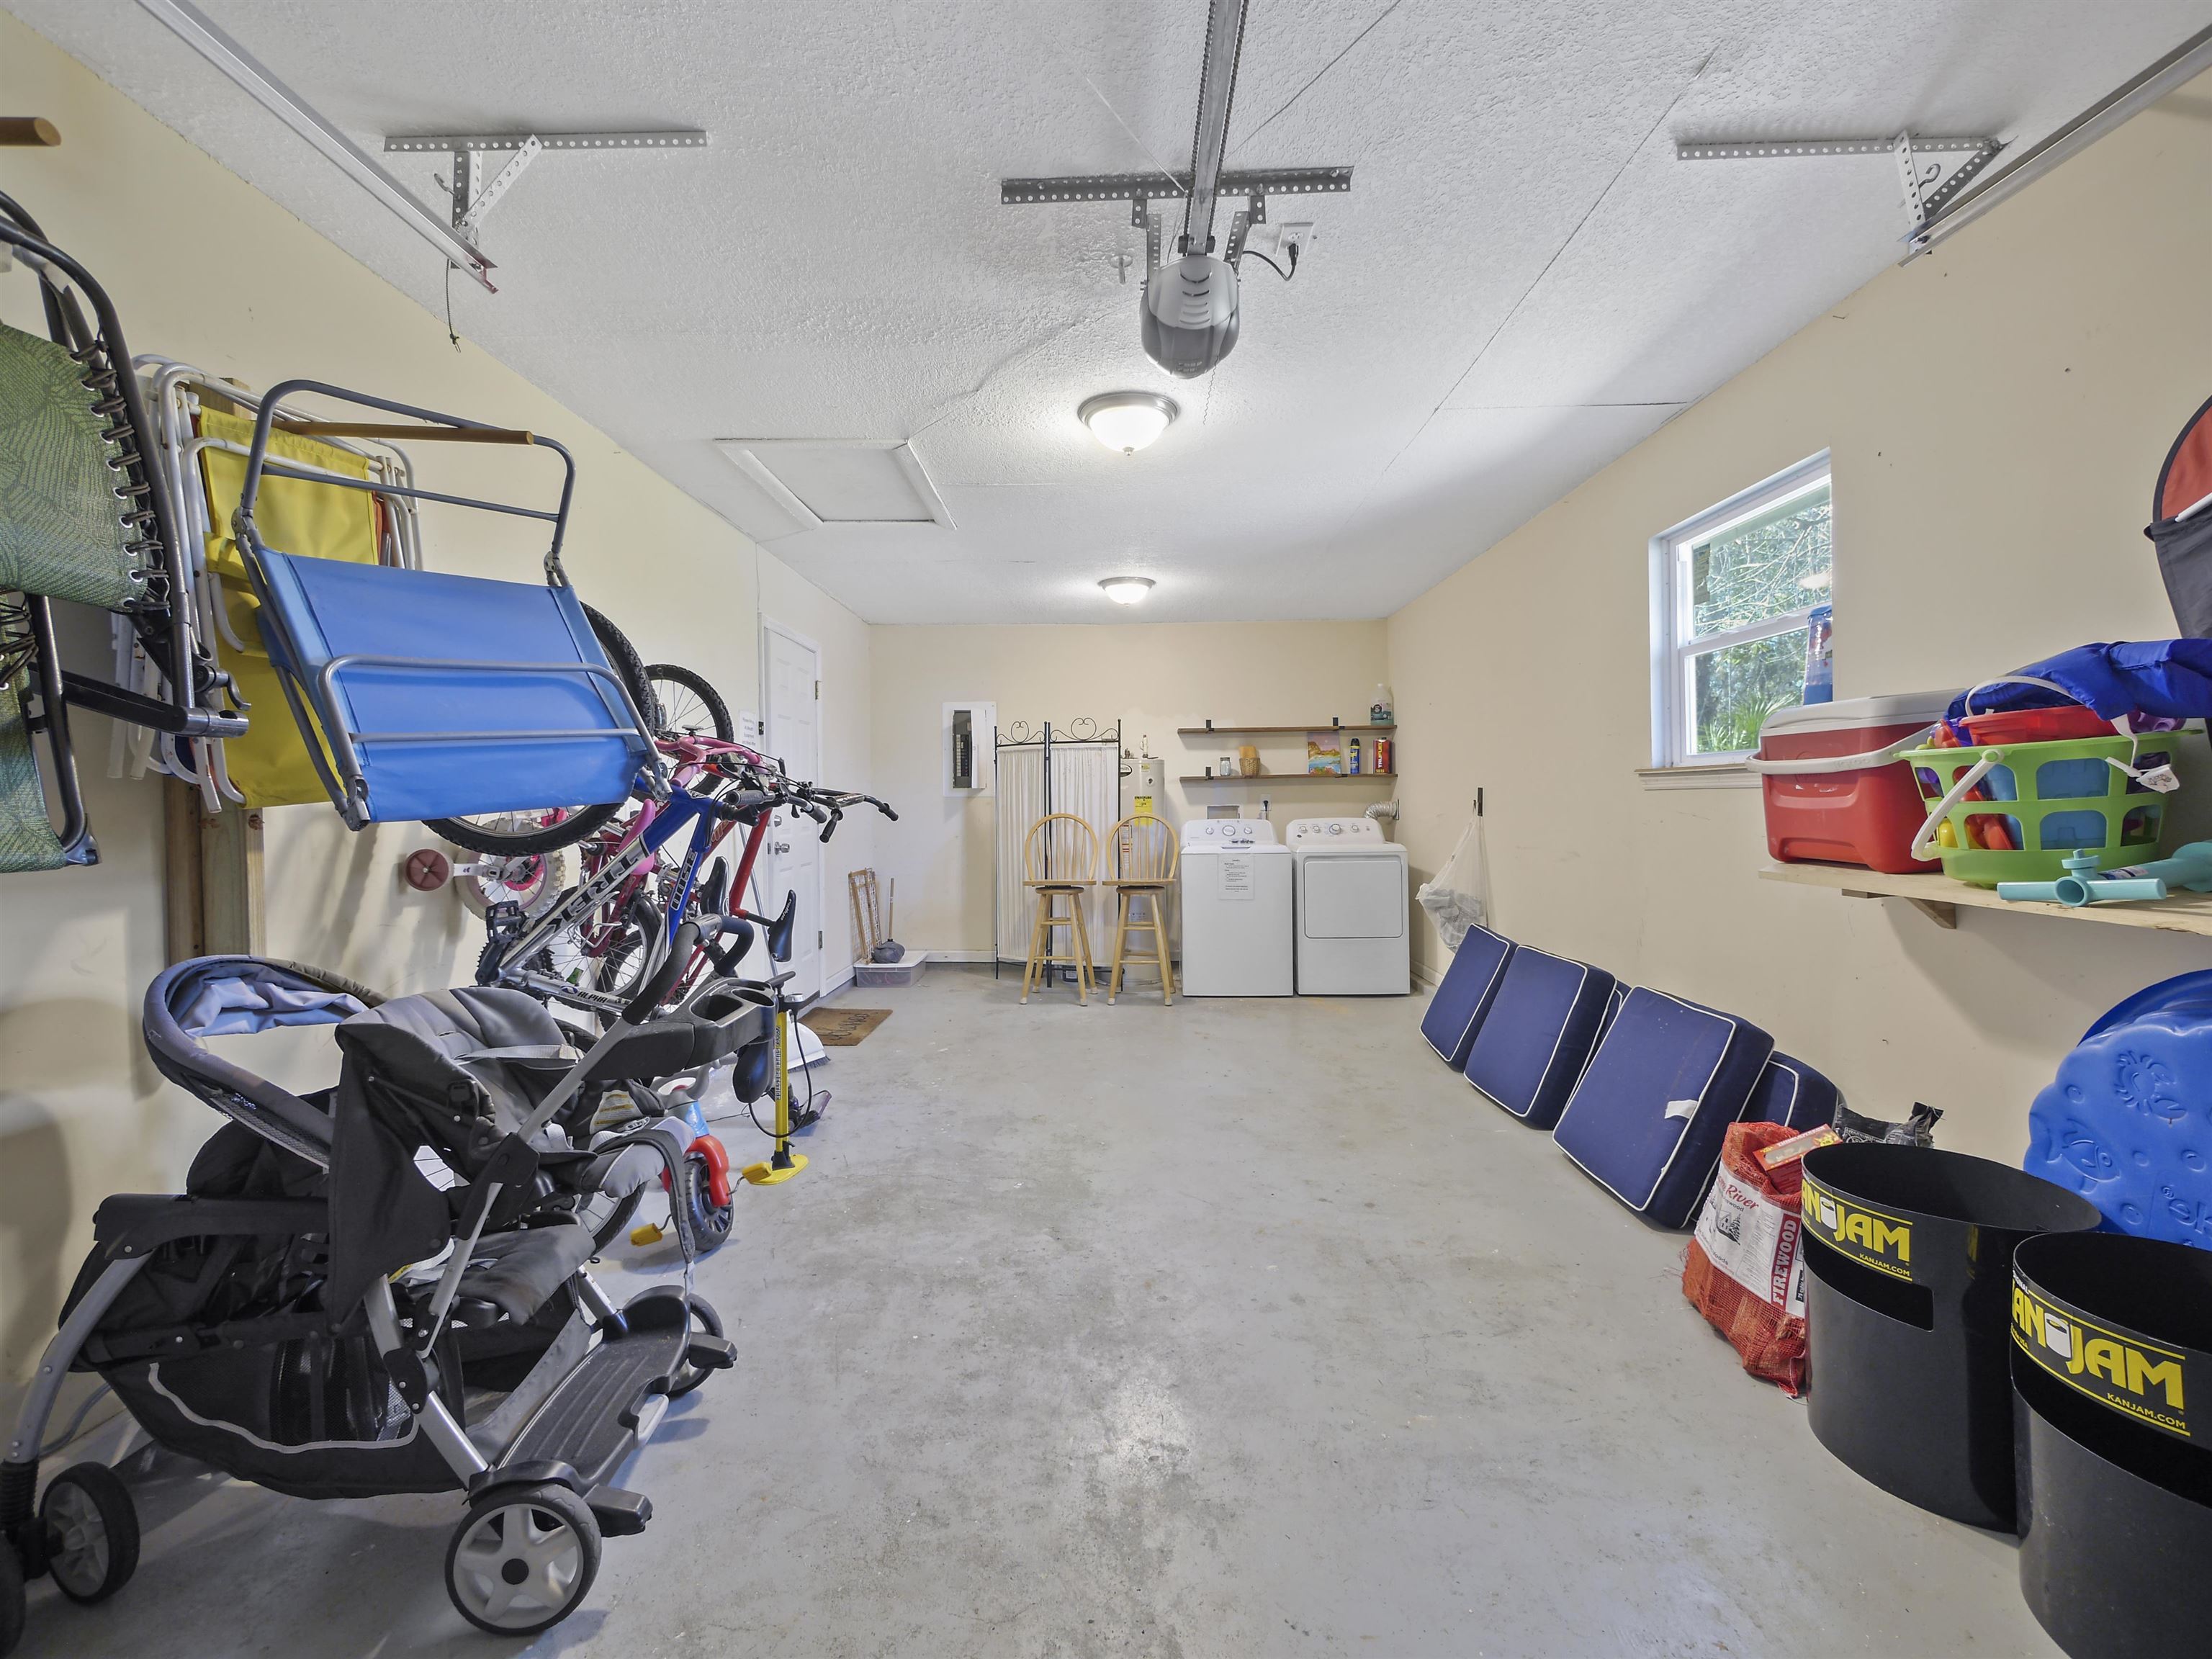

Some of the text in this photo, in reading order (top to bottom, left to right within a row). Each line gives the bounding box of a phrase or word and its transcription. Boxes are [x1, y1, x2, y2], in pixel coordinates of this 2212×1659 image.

[547, 855, 639, 933] TREK
[577, 991, 608, 1003] ALPHA
[1725, 1184, 1759, 1210] River
[1802, 1179, 1822, 1223] AN
[1833, 1204, 1910, 1262] JAM
[1772, 1220, 1797, 1305] FIREWOOD
[1859, 1253, 1910, 1277] KANJAM.COM
[2012, 1279, 2185, 1410] AN JAM
[2107, 1393, 2186, 1430] KANJAM.COM
